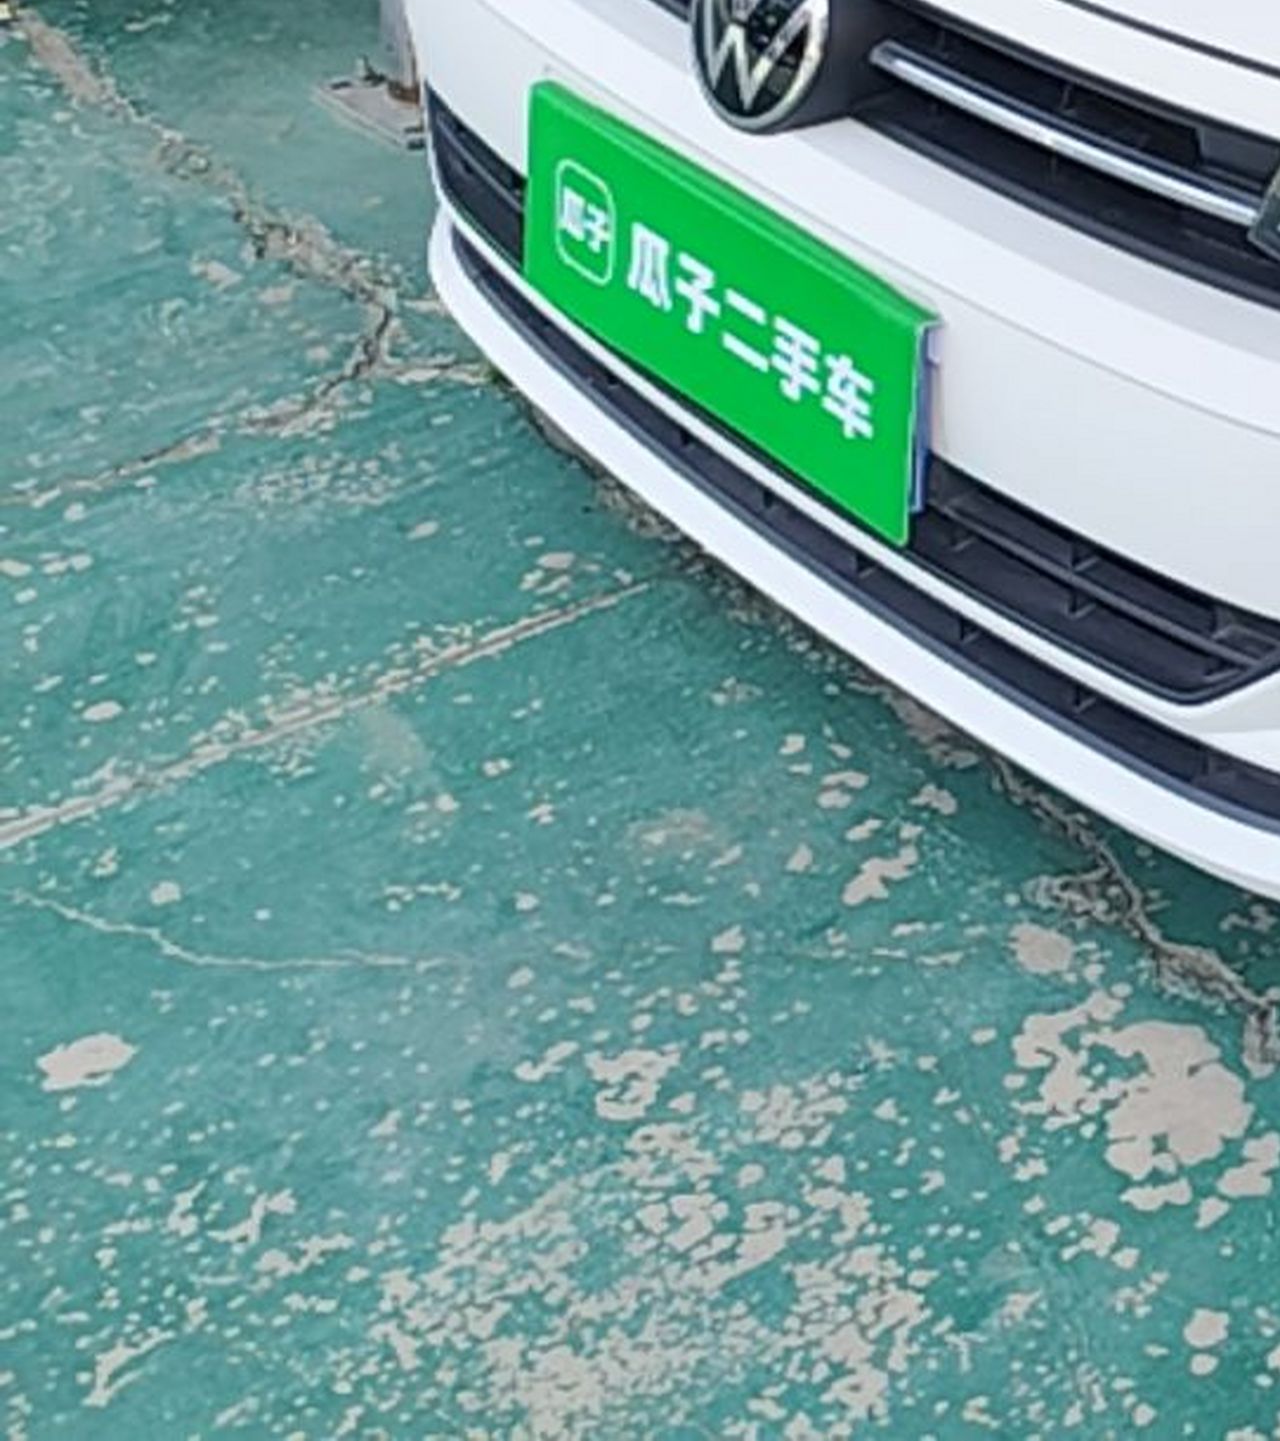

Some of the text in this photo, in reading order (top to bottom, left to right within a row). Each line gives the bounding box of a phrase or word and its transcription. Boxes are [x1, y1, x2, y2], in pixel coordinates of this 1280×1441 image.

[558, 186, 613, 253] 瓜子
[627, 222, 875, 440] 瓜子二手车
